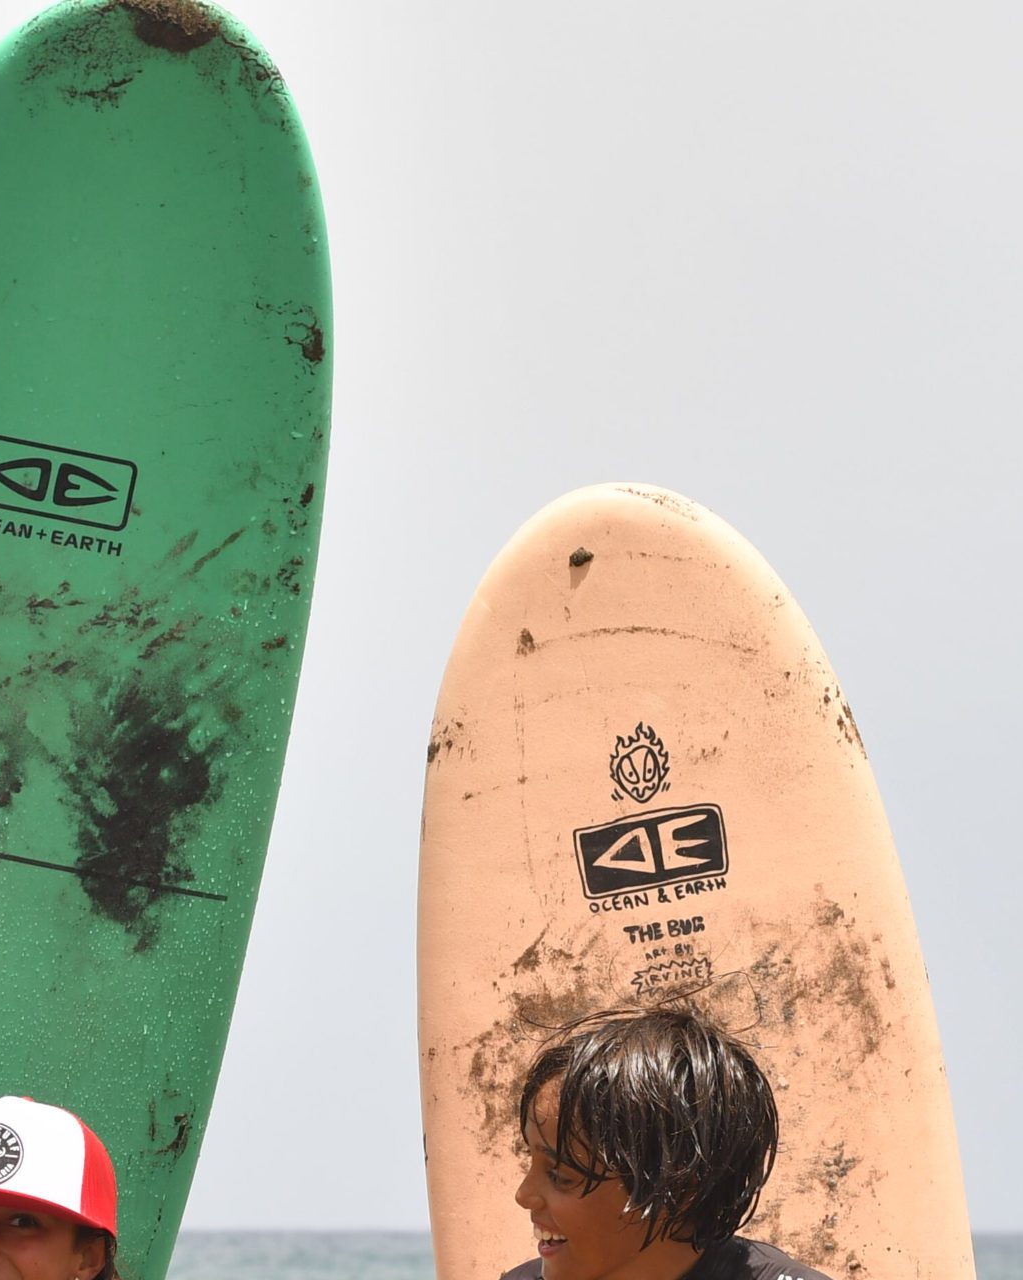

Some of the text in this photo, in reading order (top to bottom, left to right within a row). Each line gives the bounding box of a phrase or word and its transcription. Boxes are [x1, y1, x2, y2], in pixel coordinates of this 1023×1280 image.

[589, 877, 727, 914] OCEAN & EARTH
[623, 916, 705, 945] THE BUG
[645, 965, 704, 988] IRVINE
